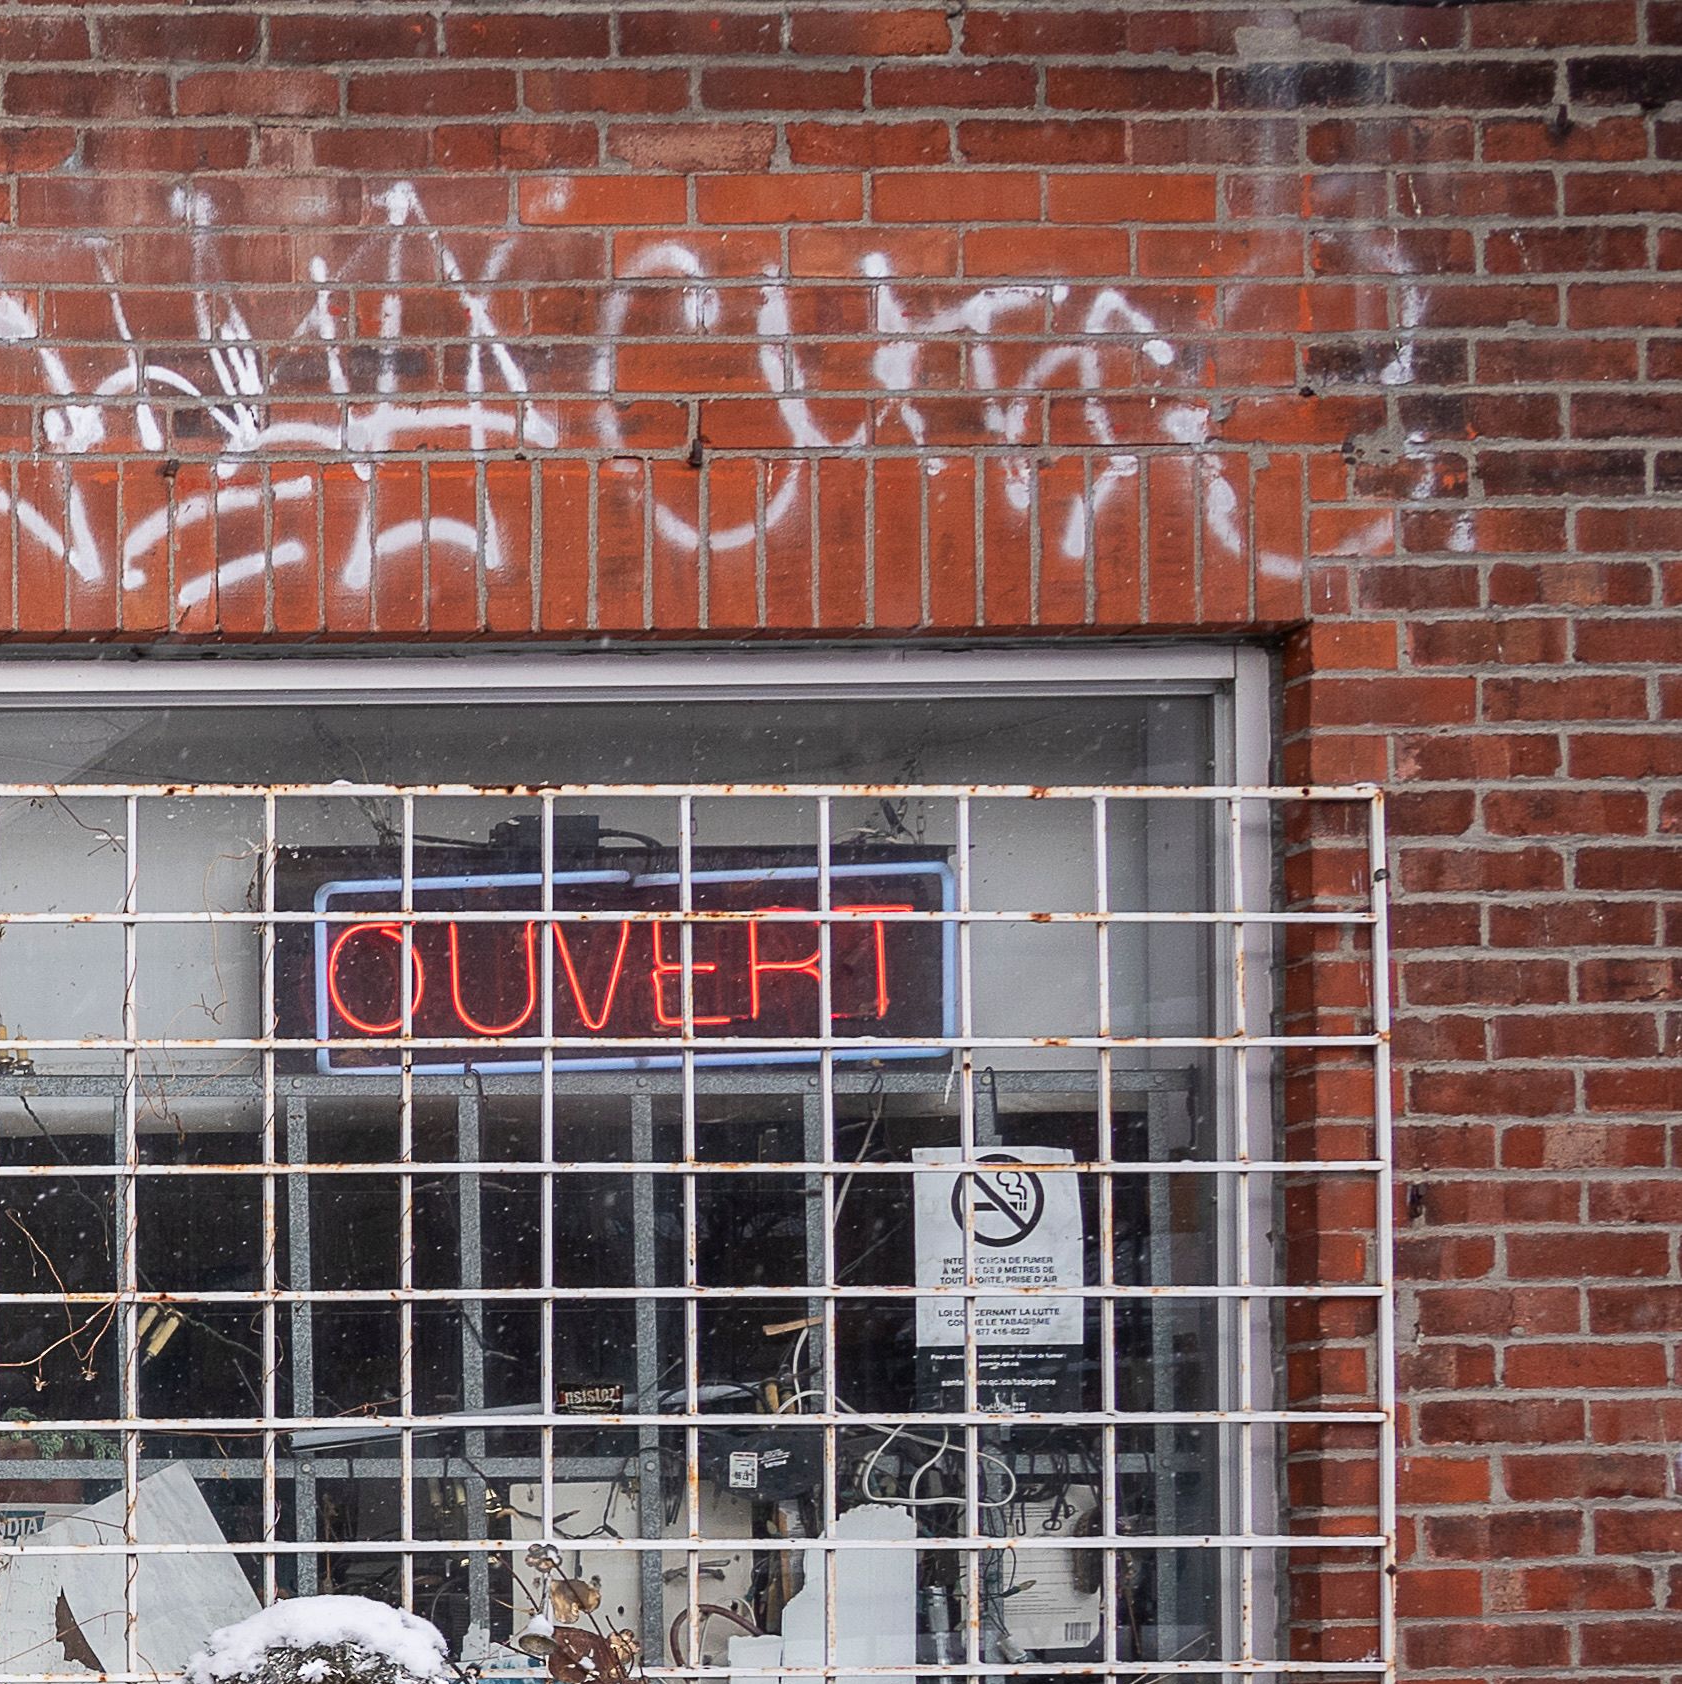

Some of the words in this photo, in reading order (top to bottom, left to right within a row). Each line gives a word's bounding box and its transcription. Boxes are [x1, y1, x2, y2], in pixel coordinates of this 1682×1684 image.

[329, 904, 915, 1034] OUVERT
[943, 1256, 1007, 1264] INTECTION
[954, 1308, 1017, 1317] COCERNANT
